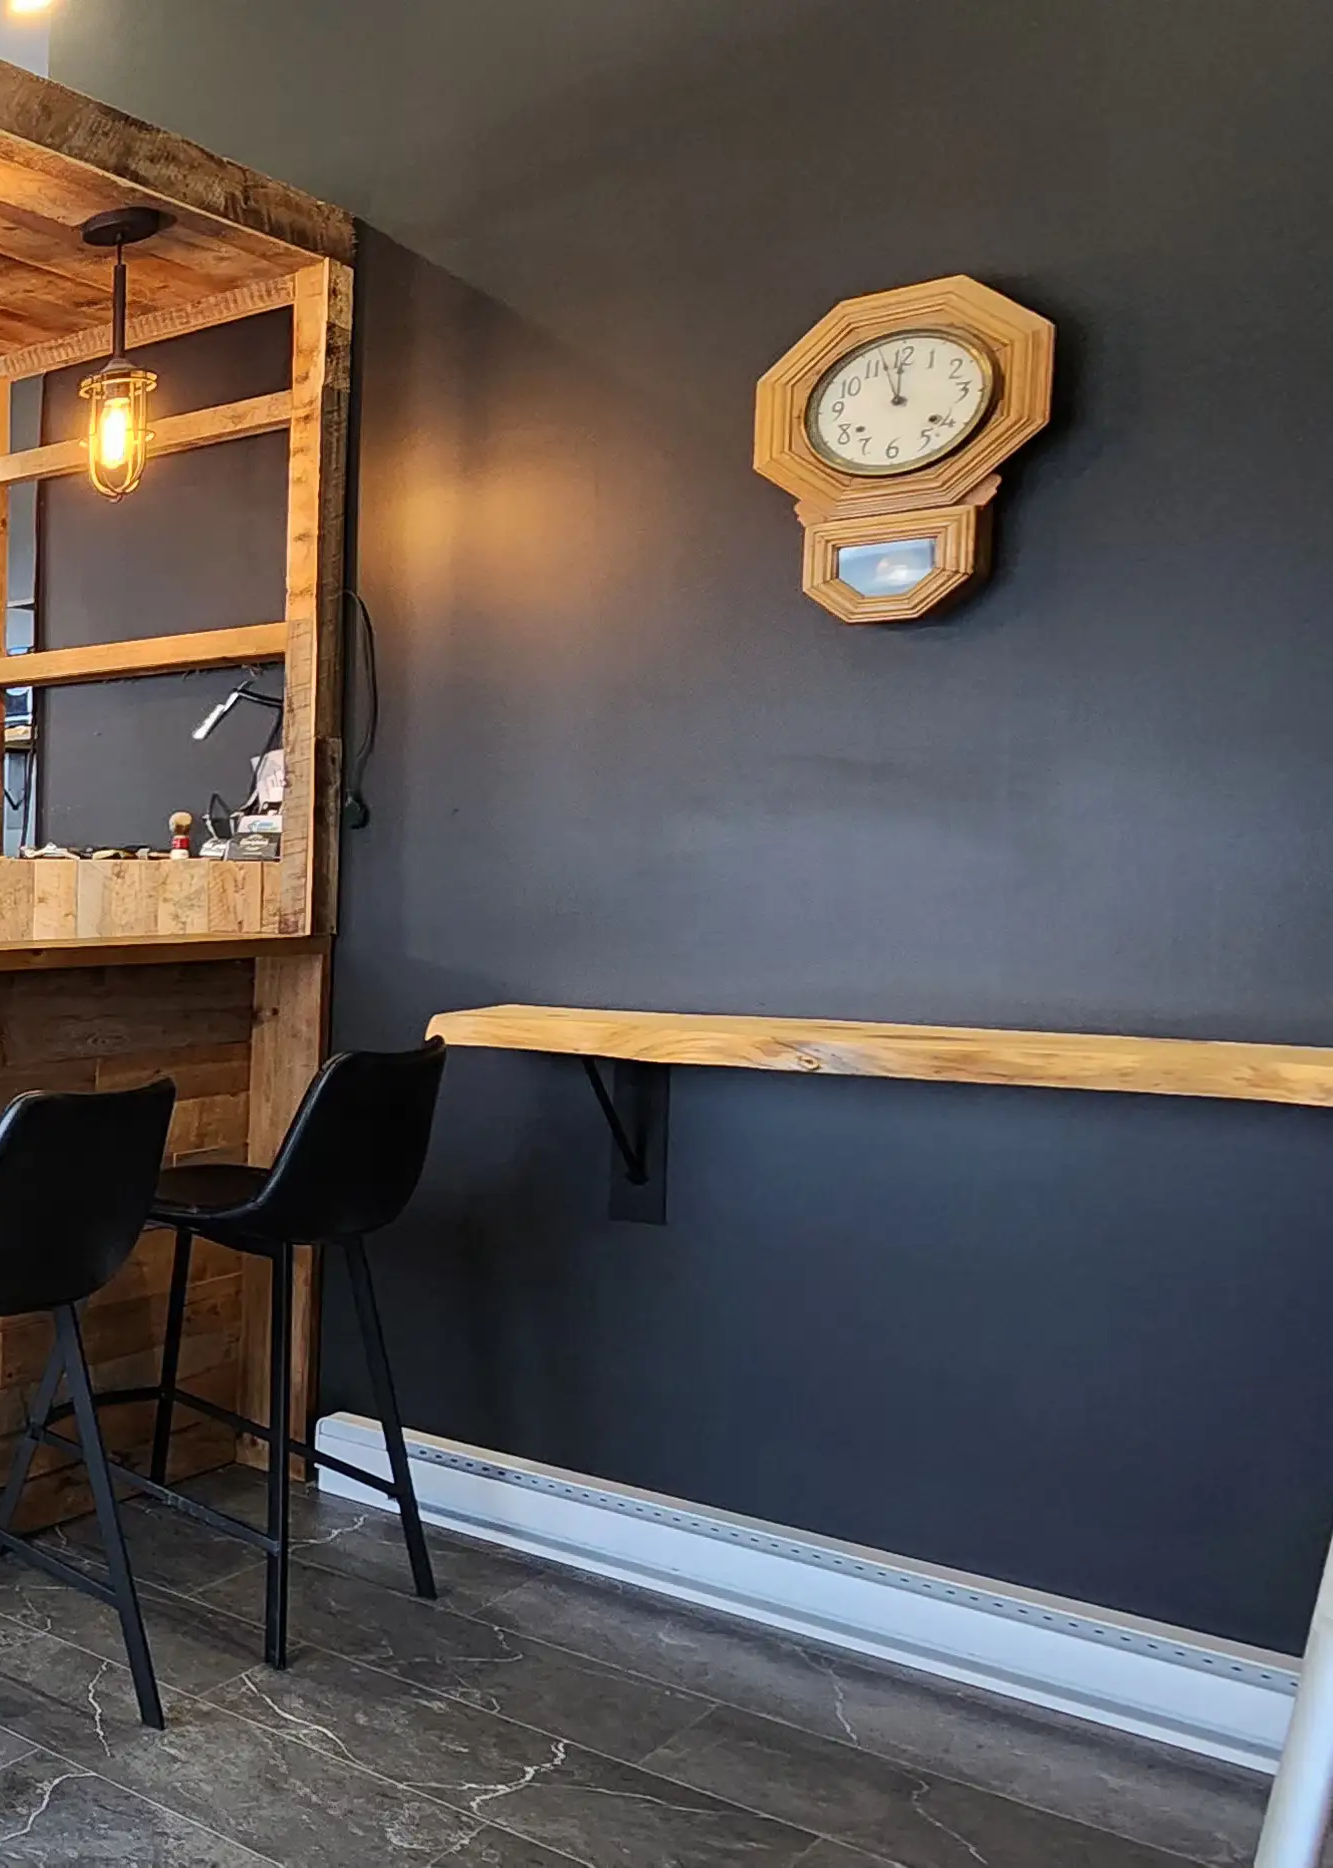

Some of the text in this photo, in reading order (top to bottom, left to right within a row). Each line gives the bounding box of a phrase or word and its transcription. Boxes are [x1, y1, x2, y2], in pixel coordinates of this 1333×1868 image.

[893, 346, 915, 369] 12
[927, 349, 935, 369] 1
[864, 359, 880, 379] 11
[948, 358, 964, 380] 2
[840, 376, 862, 399] 10
[954, 380, 972, 403] 3
[831, 401, 845, 422] 9
[939, 407, 956, 428] 4
[837, 423, 851, 445] 8
[917, 427, 933, 452] 5
[858, 437, 872, 456] 7
[885, 437, 901, 459] 6
